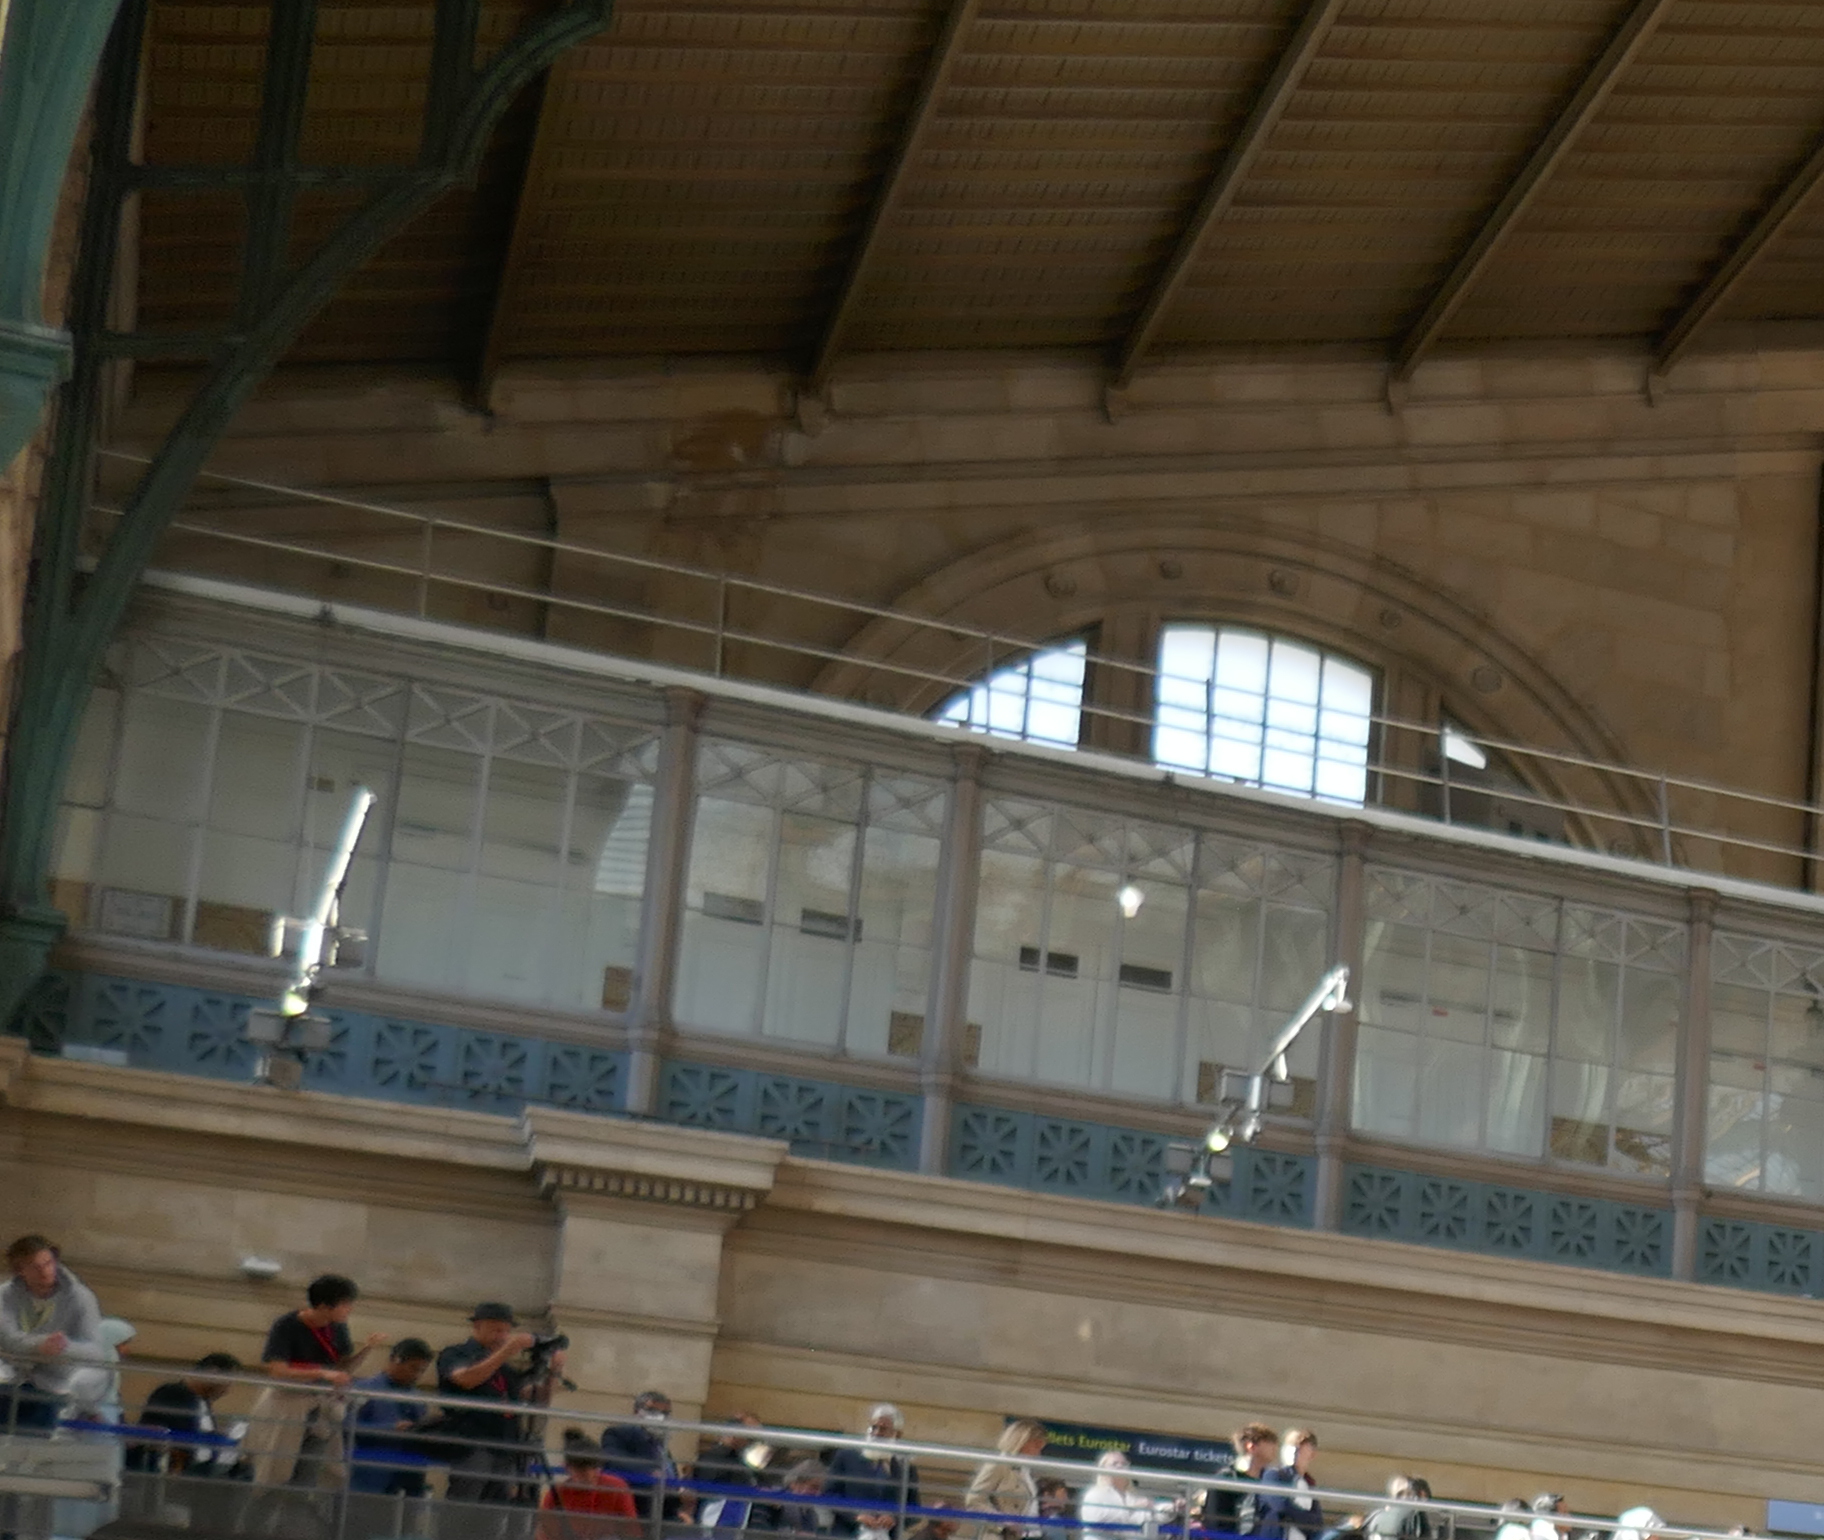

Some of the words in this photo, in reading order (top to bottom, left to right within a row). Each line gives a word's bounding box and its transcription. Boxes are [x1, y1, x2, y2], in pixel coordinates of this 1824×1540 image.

[1076, 1433, 1132, 1452] Eurostar
[1138, 1441, 1192, 1460] Eurostar
[1194, 1449, 1235, 1465] tickets
